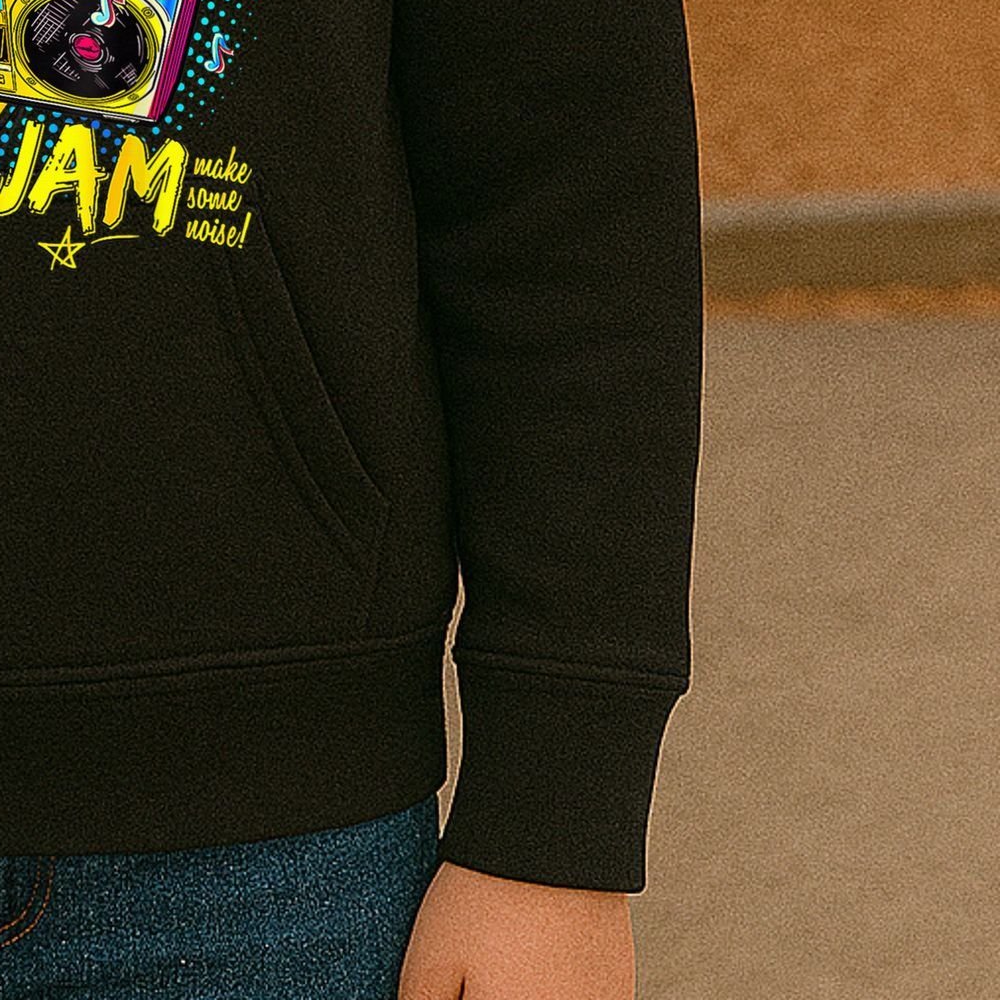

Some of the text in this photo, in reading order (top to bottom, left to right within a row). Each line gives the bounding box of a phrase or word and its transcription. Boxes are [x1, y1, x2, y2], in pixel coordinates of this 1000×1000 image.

[192, 147, 252, 185] make
[187, 181, 242, 213] some
[185, 213, 251, 248] noise!
